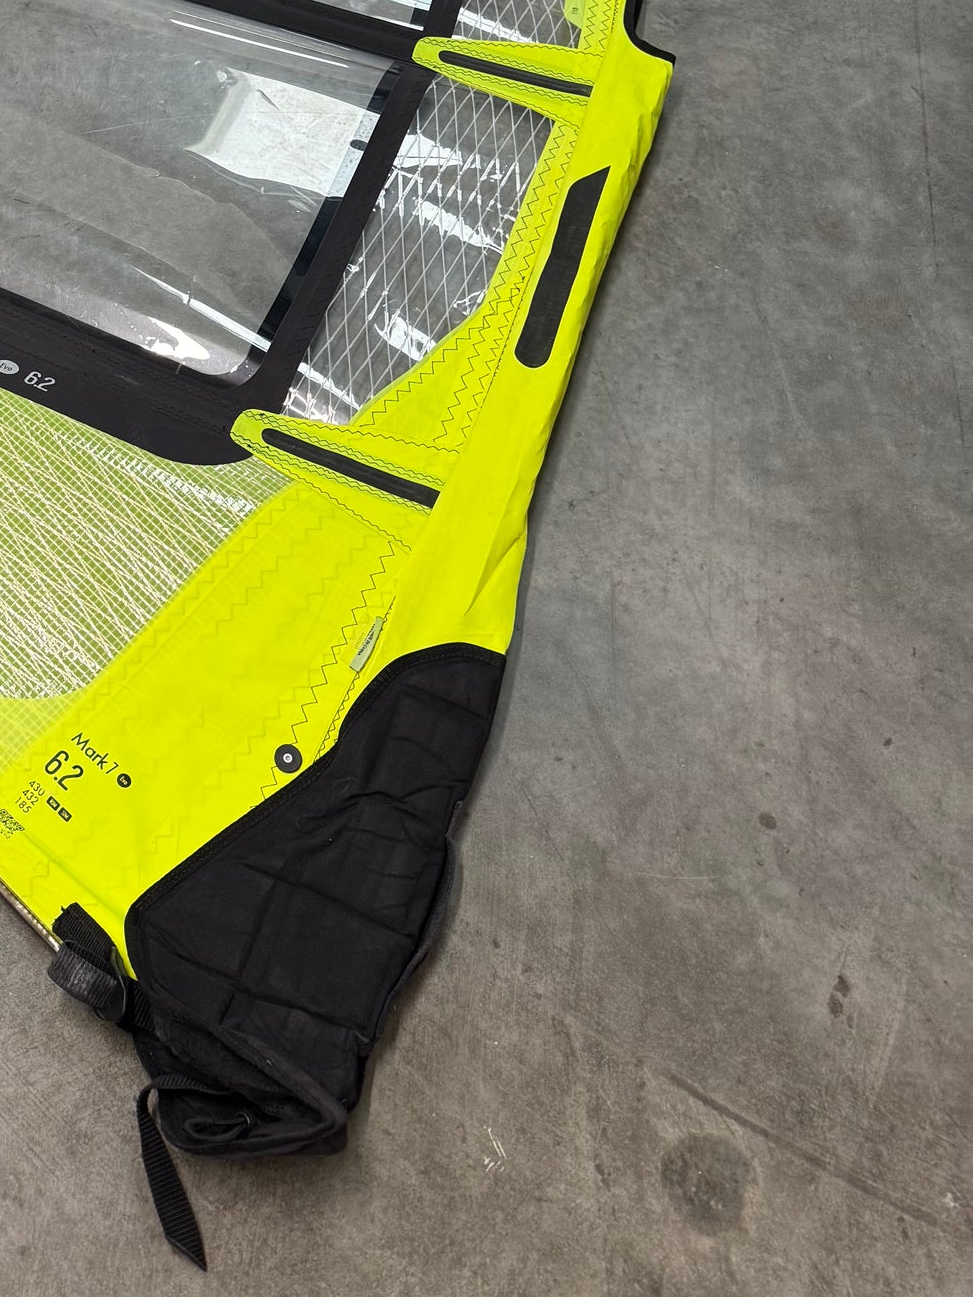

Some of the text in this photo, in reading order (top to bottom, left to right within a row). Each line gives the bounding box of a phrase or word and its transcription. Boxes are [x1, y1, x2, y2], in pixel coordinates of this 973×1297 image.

[23, 370, 56, 393] 6.2
[71, 732, 109, 770] Mark
[105, 761, 119, 775] 7
[44, 750, 84, 791] 6.2
[22, 790, 39, 805] 432
[29, 781, 45, 796] 430
[15, 797, 32, 813] 185
